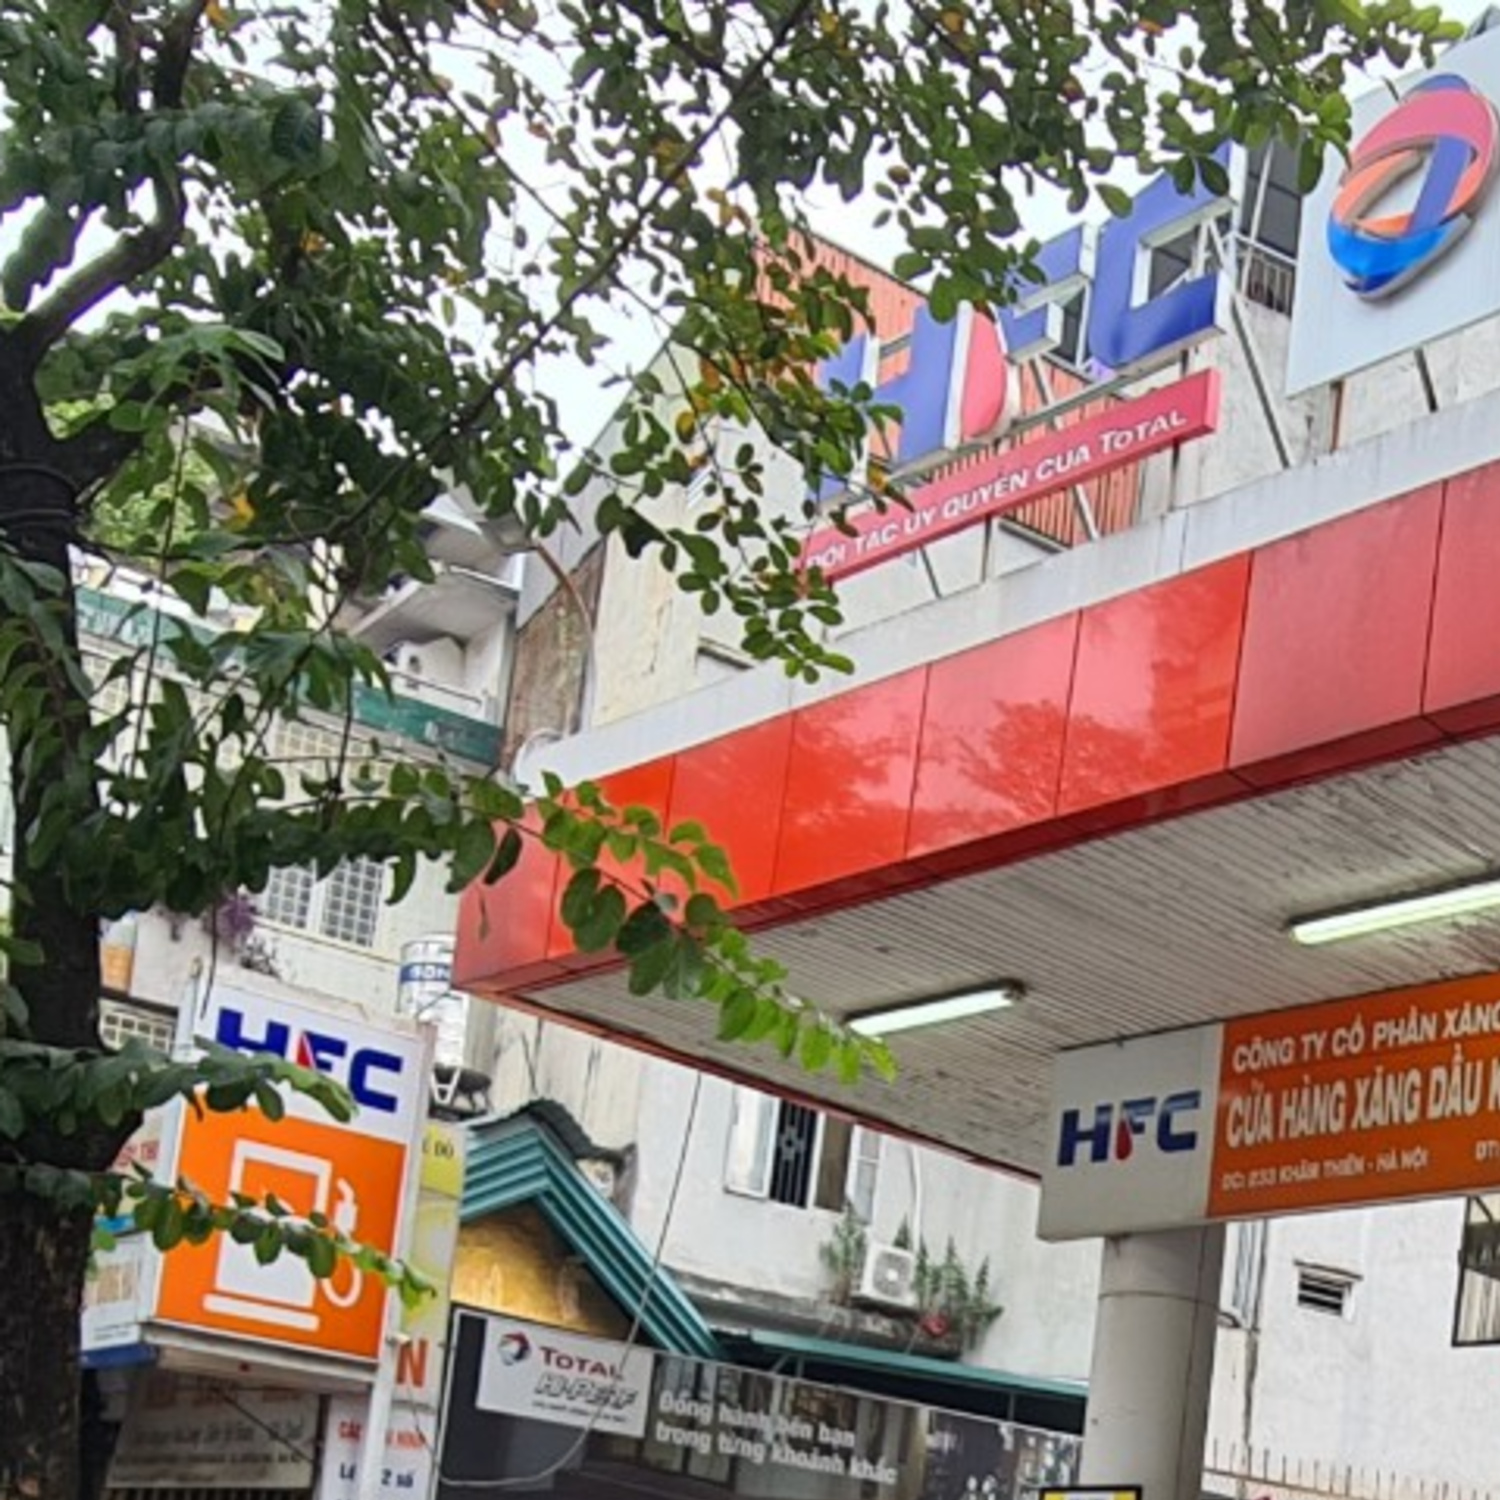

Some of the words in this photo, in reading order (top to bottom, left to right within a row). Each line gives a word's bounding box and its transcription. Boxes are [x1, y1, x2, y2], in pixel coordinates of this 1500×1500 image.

[1099, 407, 1188, 456] TOTAL
[1232, 1032, 1296, 1075] CÔNG
[1301, 1029, 1328, 1062] TY
[1056, 1090, 1203, 1168] HFC
[538, 1345, 625, 1381] TOTAL
